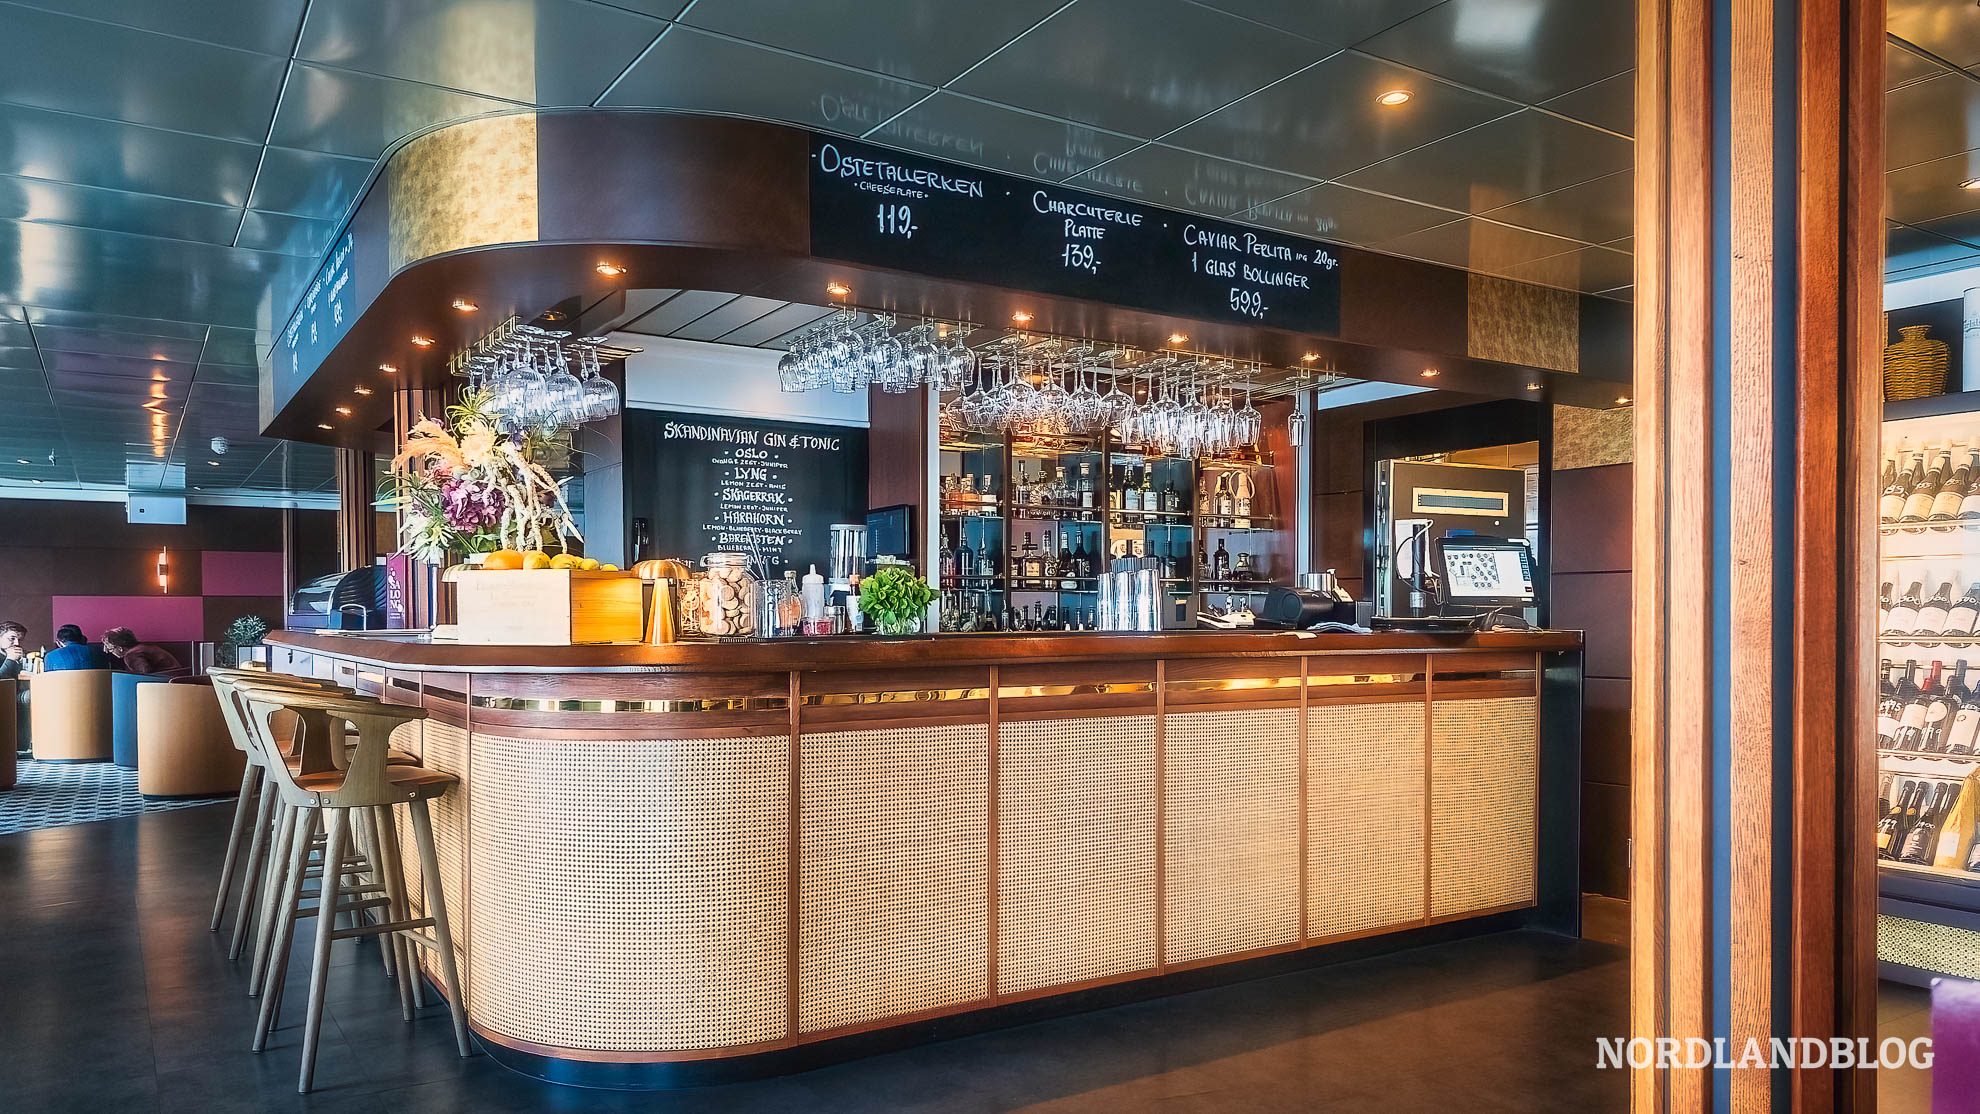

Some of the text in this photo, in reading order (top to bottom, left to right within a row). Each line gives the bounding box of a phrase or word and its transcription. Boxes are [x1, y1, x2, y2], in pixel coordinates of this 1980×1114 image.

[821, 144, 983, 198] OSTETALLERKEN
[1033, 190, 1144, 227] CHARCUTERIE
[1064, 218, 1106, 239] PLATTE
[1183, 224, 1242, 252] CAVIAR
[1243, 232, 1292, 262] PERLITA
[1191, 251, 1310, 290] 1 GLAS BOLLINGER
[663, 420, 760, 446] SKANDINAVIAN
[763, 432, 787, 448] GIN
[799, 435, 840, 451] TONIC
[735, 447, 769, 460] OSLO
[734, 466, 768, 482] LYNG
[722, 487, 786, 505] SKAGERRAK
[722, 510, 785, 527] HARAHORN
[717, 544, 783, 554] BLUEBERR MINT
